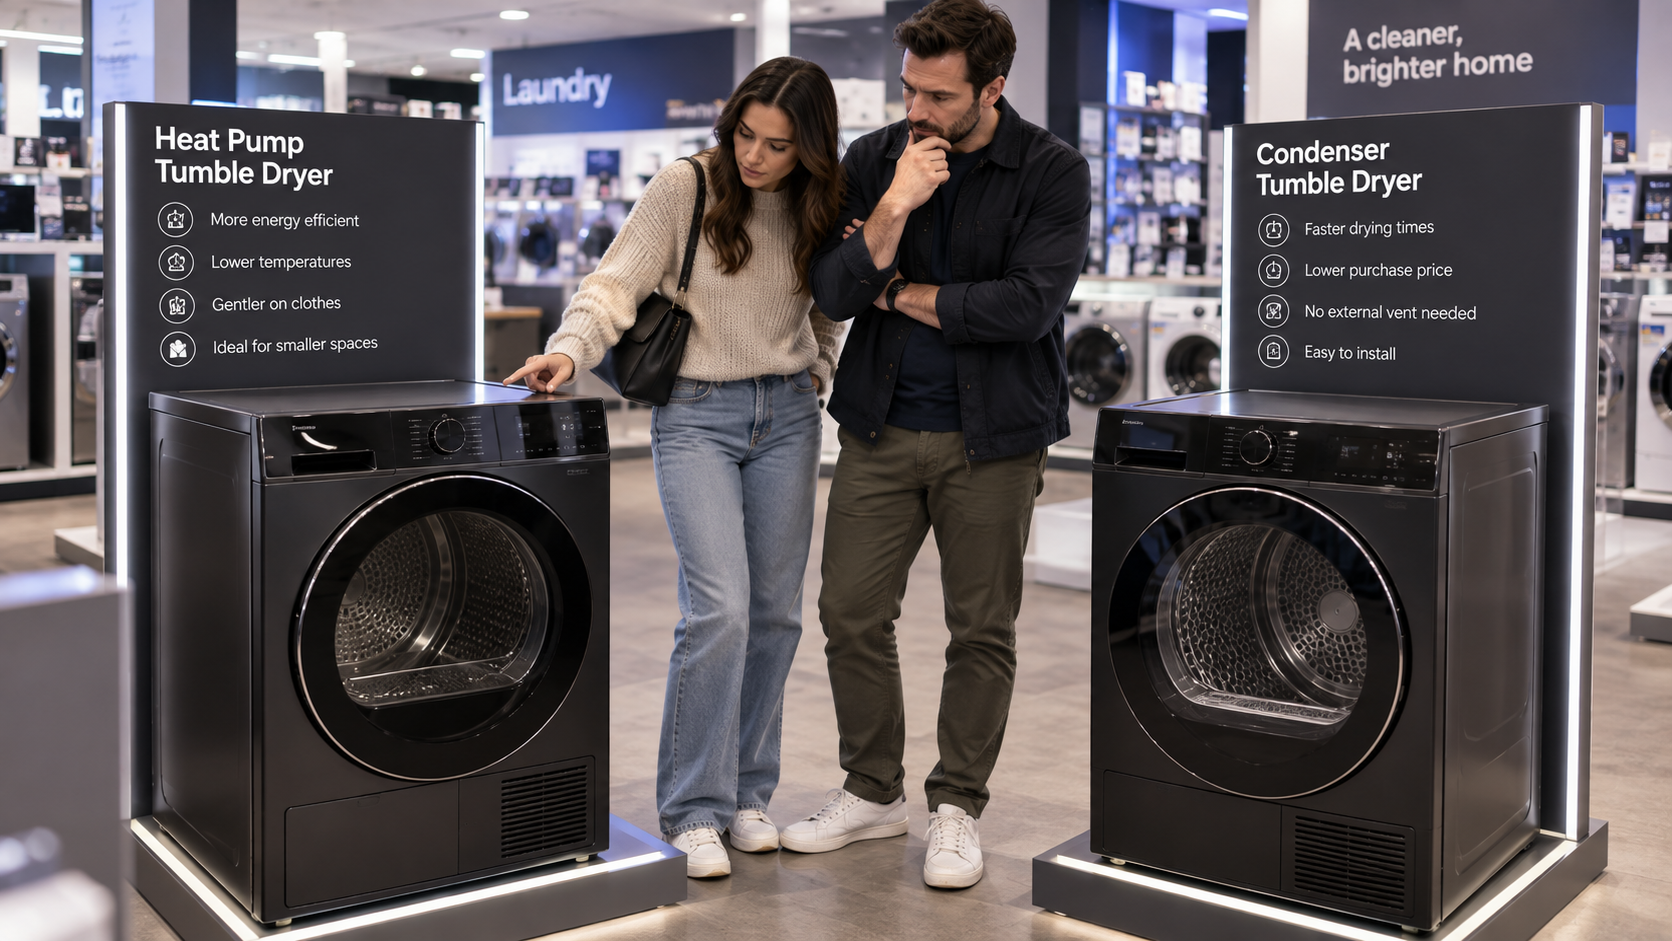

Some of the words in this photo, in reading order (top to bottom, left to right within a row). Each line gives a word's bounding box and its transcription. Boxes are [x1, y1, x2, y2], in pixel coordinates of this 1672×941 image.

[1342, 27, 1363, 53] A
[1366, 24, 1463, 51] cleaner,
[1343, 56, 1447, 88] brighter
[1453, 51, 1534, 77] home
[502, 68, 612, 109] Laundry
[154, 125, 221, 152] Heat
[228, 129, 305, 159] Pump
[1256, 139, 1391, 166] Condenser
[154, 159, 255, 185] Tumble
[262, 163, 334, 191] Dryer
[1256, 170, 1345, 196] Tumble
[1352, 169, 1423, 199] Dryer
[211, 212, 248, 227] More
[252, 215, 301, 231] energy
[304, 212, 360, 227] efficient
[1305, 222, 1346, 236] Faster
[1349, 220, 1392, 239] drying
[1396, 220, 1435, 234] times
[211, 254, 256, 269] Lower
[258, 255, 352, 272] temperatures
[1305, 263, 1346, 277] Lower
[1349, 262, 1413, 280] purchase
[1417, 262, 1453, 281] price
[211, 296, 266, 312] Gentler
[269, 299, 288, 311] on
[291, 295, 342, 310] clothes
[1305, 304, 1325, 318] No
[1327, 304, 1383, 319] external
[1386, 306, 1418, 320] vent
[1421, 305, 1477, 321] needed
[213, 339, 248, 355] Ideal
[251, 338, 273, 353] for
[275, 337, 327, 352] smaller
[330, 338, 379, 354] spaces
[1305, 344, 1336, 362] Easy
[1338, 346, 1354, 360] to
[1356, 346, 1396, 361] install
